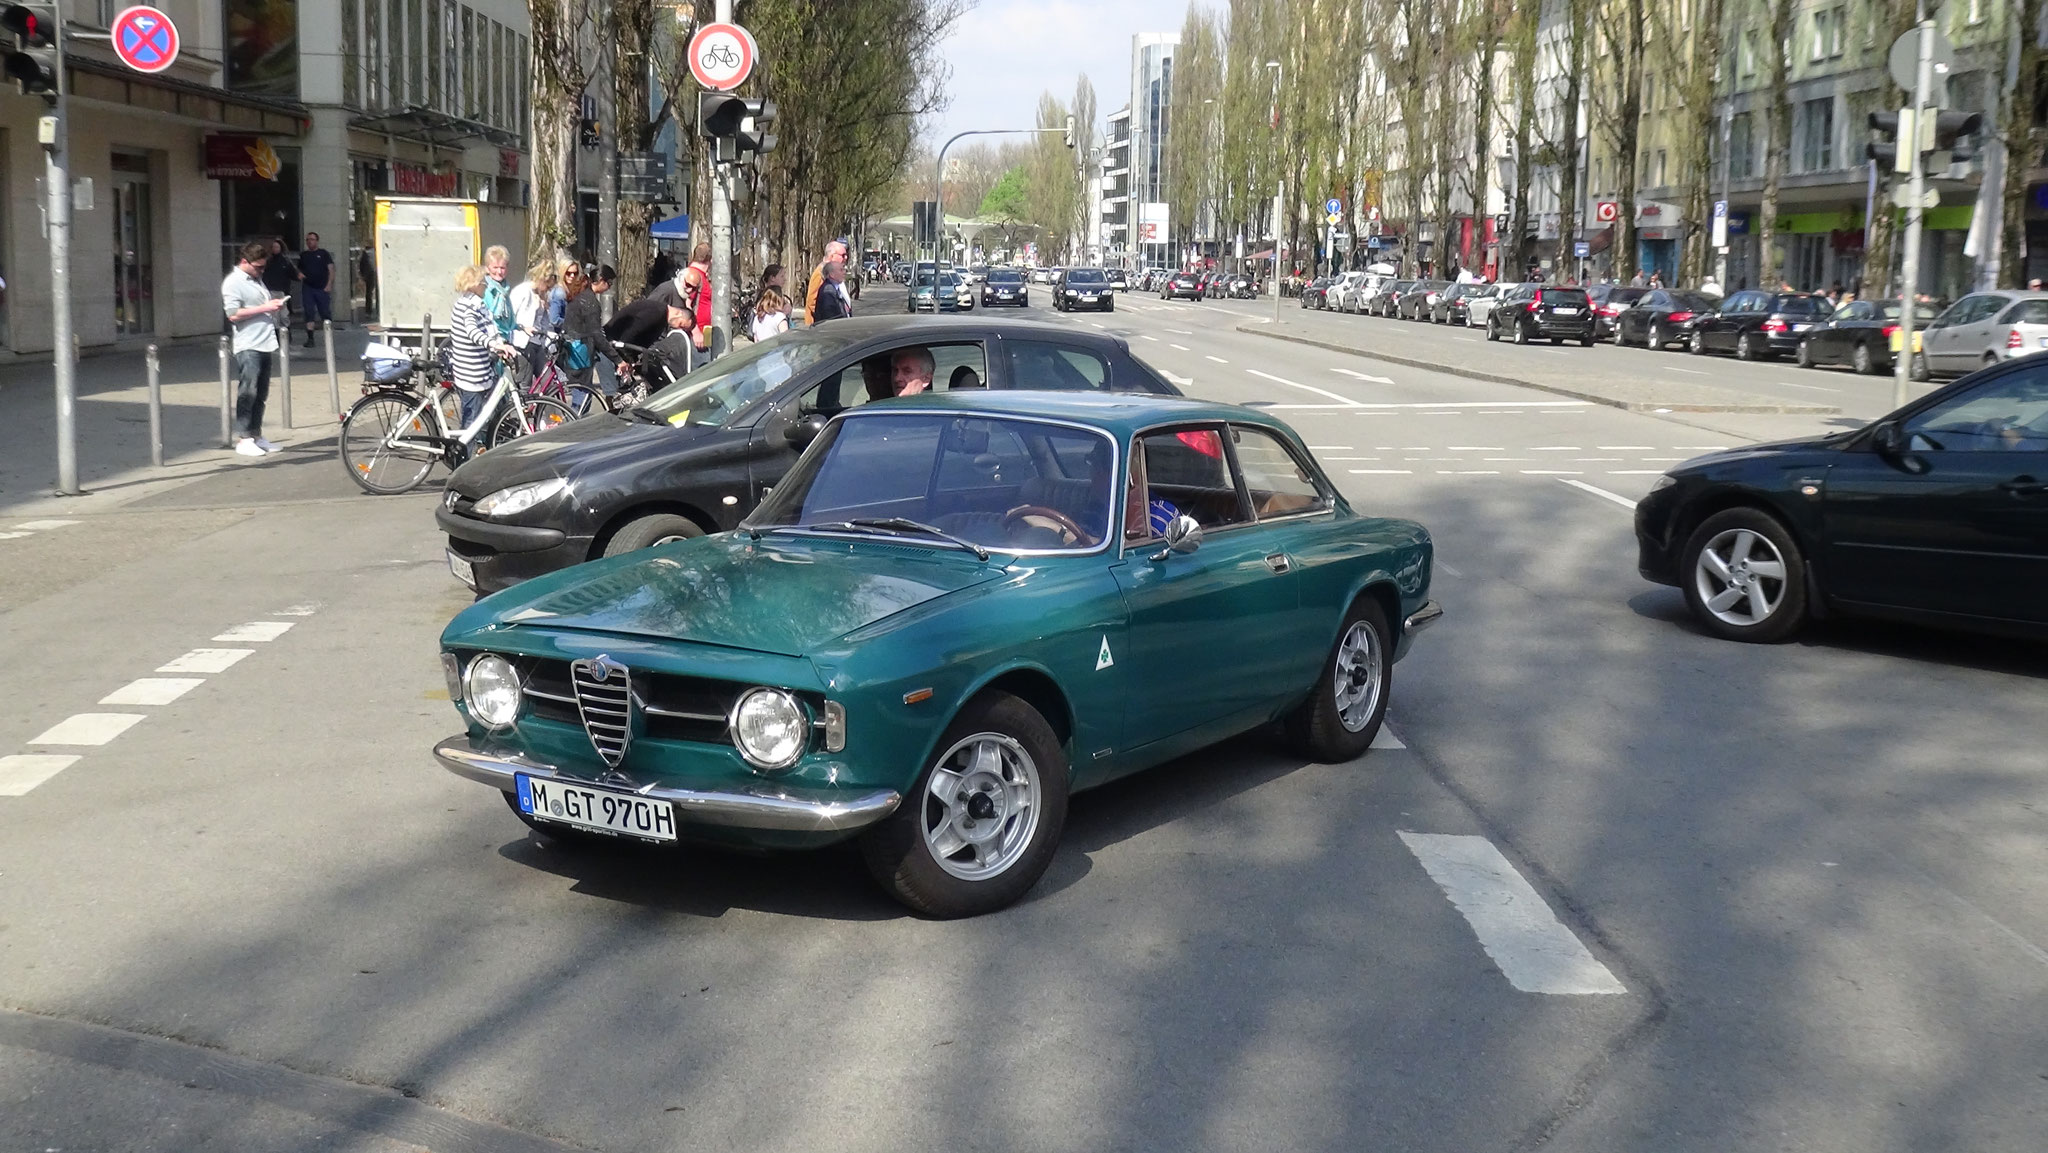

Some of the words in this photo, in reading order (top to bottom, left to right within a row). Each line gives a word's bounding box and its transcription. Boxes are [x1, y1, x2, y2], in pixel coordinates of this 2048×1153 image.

[531, 782, 549, 812] M
[564, 789, 595, 821] GT
[602, 796, 674, 835] 970H
